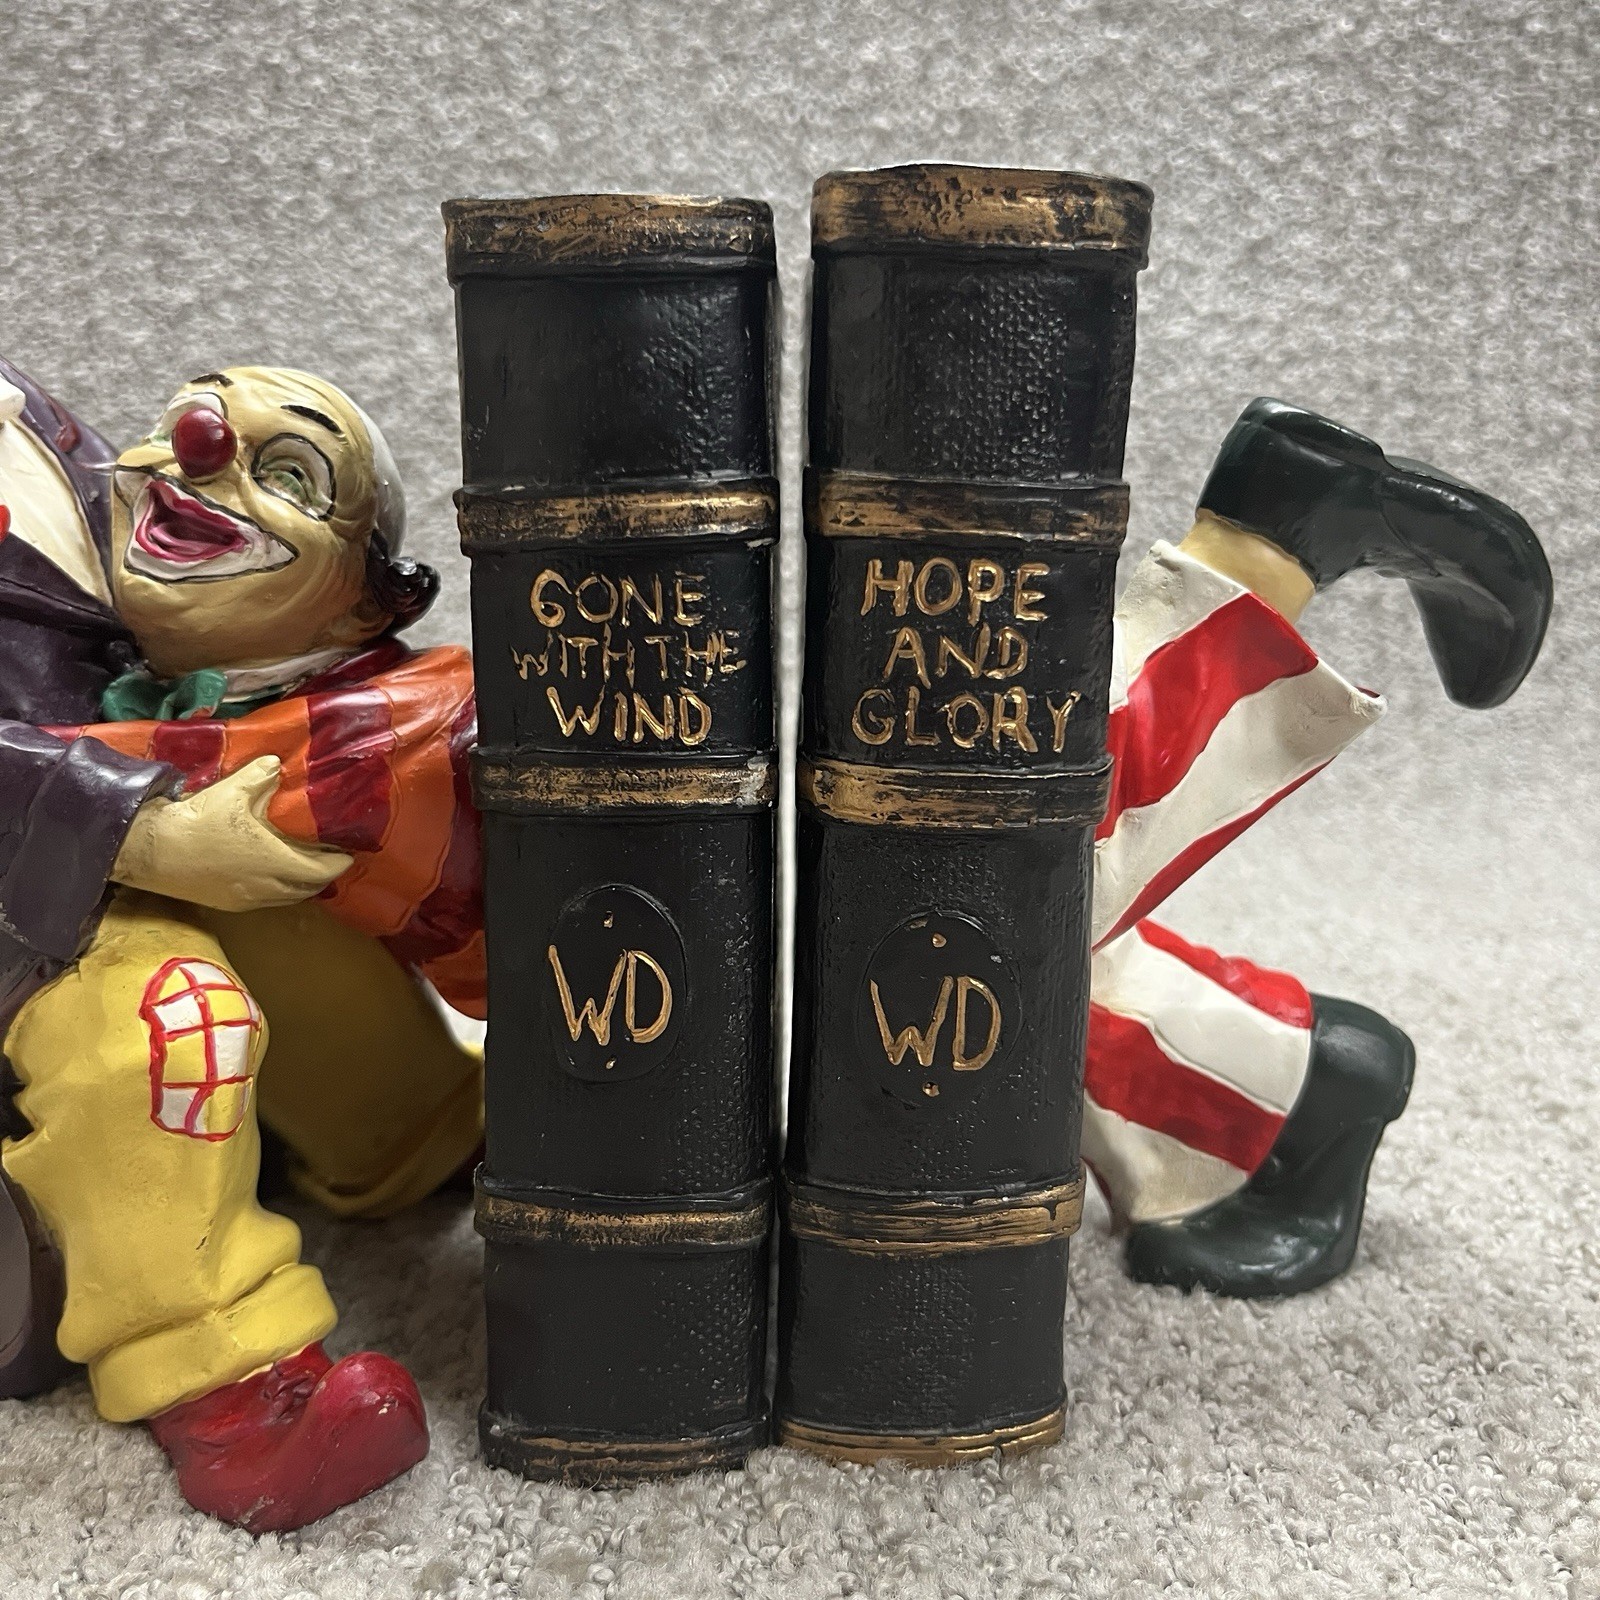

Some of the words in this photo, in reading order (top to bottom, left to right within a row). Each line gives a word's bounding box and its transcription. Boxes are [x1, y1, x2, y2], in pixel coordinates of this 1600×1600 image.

[531, 569, 706, 627] GONE
[861, 557, 1049, 626] HOPE
[510, 623, 636, 687] WITH
[644, 629, 747, 687] THE
[883, 622, 1028, 689] AND
[547, 685, 712, 745] WIND
[852, 686, 1081, 753] GLORY
[548, 945, 673, 1046] WD
[870, 976, 1001, 1071] WD
